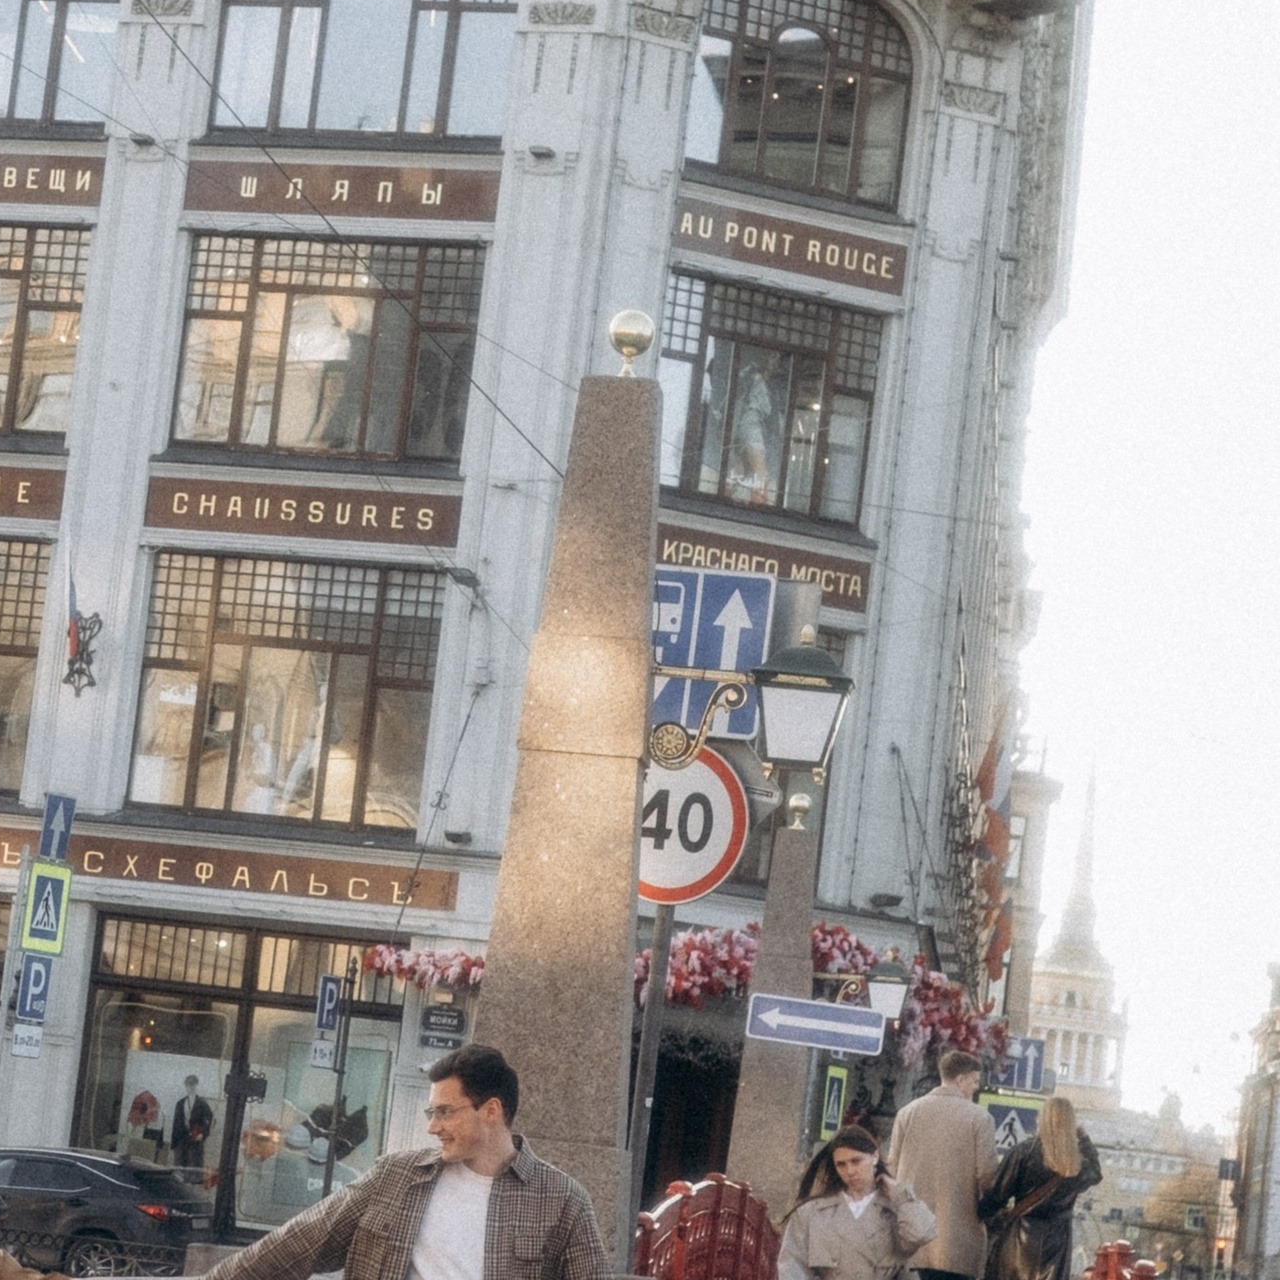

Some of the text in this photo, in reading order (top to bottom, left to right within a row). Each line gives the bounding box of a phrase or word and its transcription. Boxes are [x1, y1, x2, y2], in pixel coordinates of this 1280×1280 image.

[3, 166, 92, 193] ВЕЩИ
[240, 176, 443, 207] ШЛЯПЫ
[680, 211, 895, 280] AU PONT ROUGE
[172, 491, 435, 532] CHAUSSURES
[790, 563, 863, 598] МОСТА
[641, 788, 714, 854] 40
[82, 850, 415, 906] СХЕФАЛЬСЪ
[429, 1014, 459, 1026] МОЙКИ
